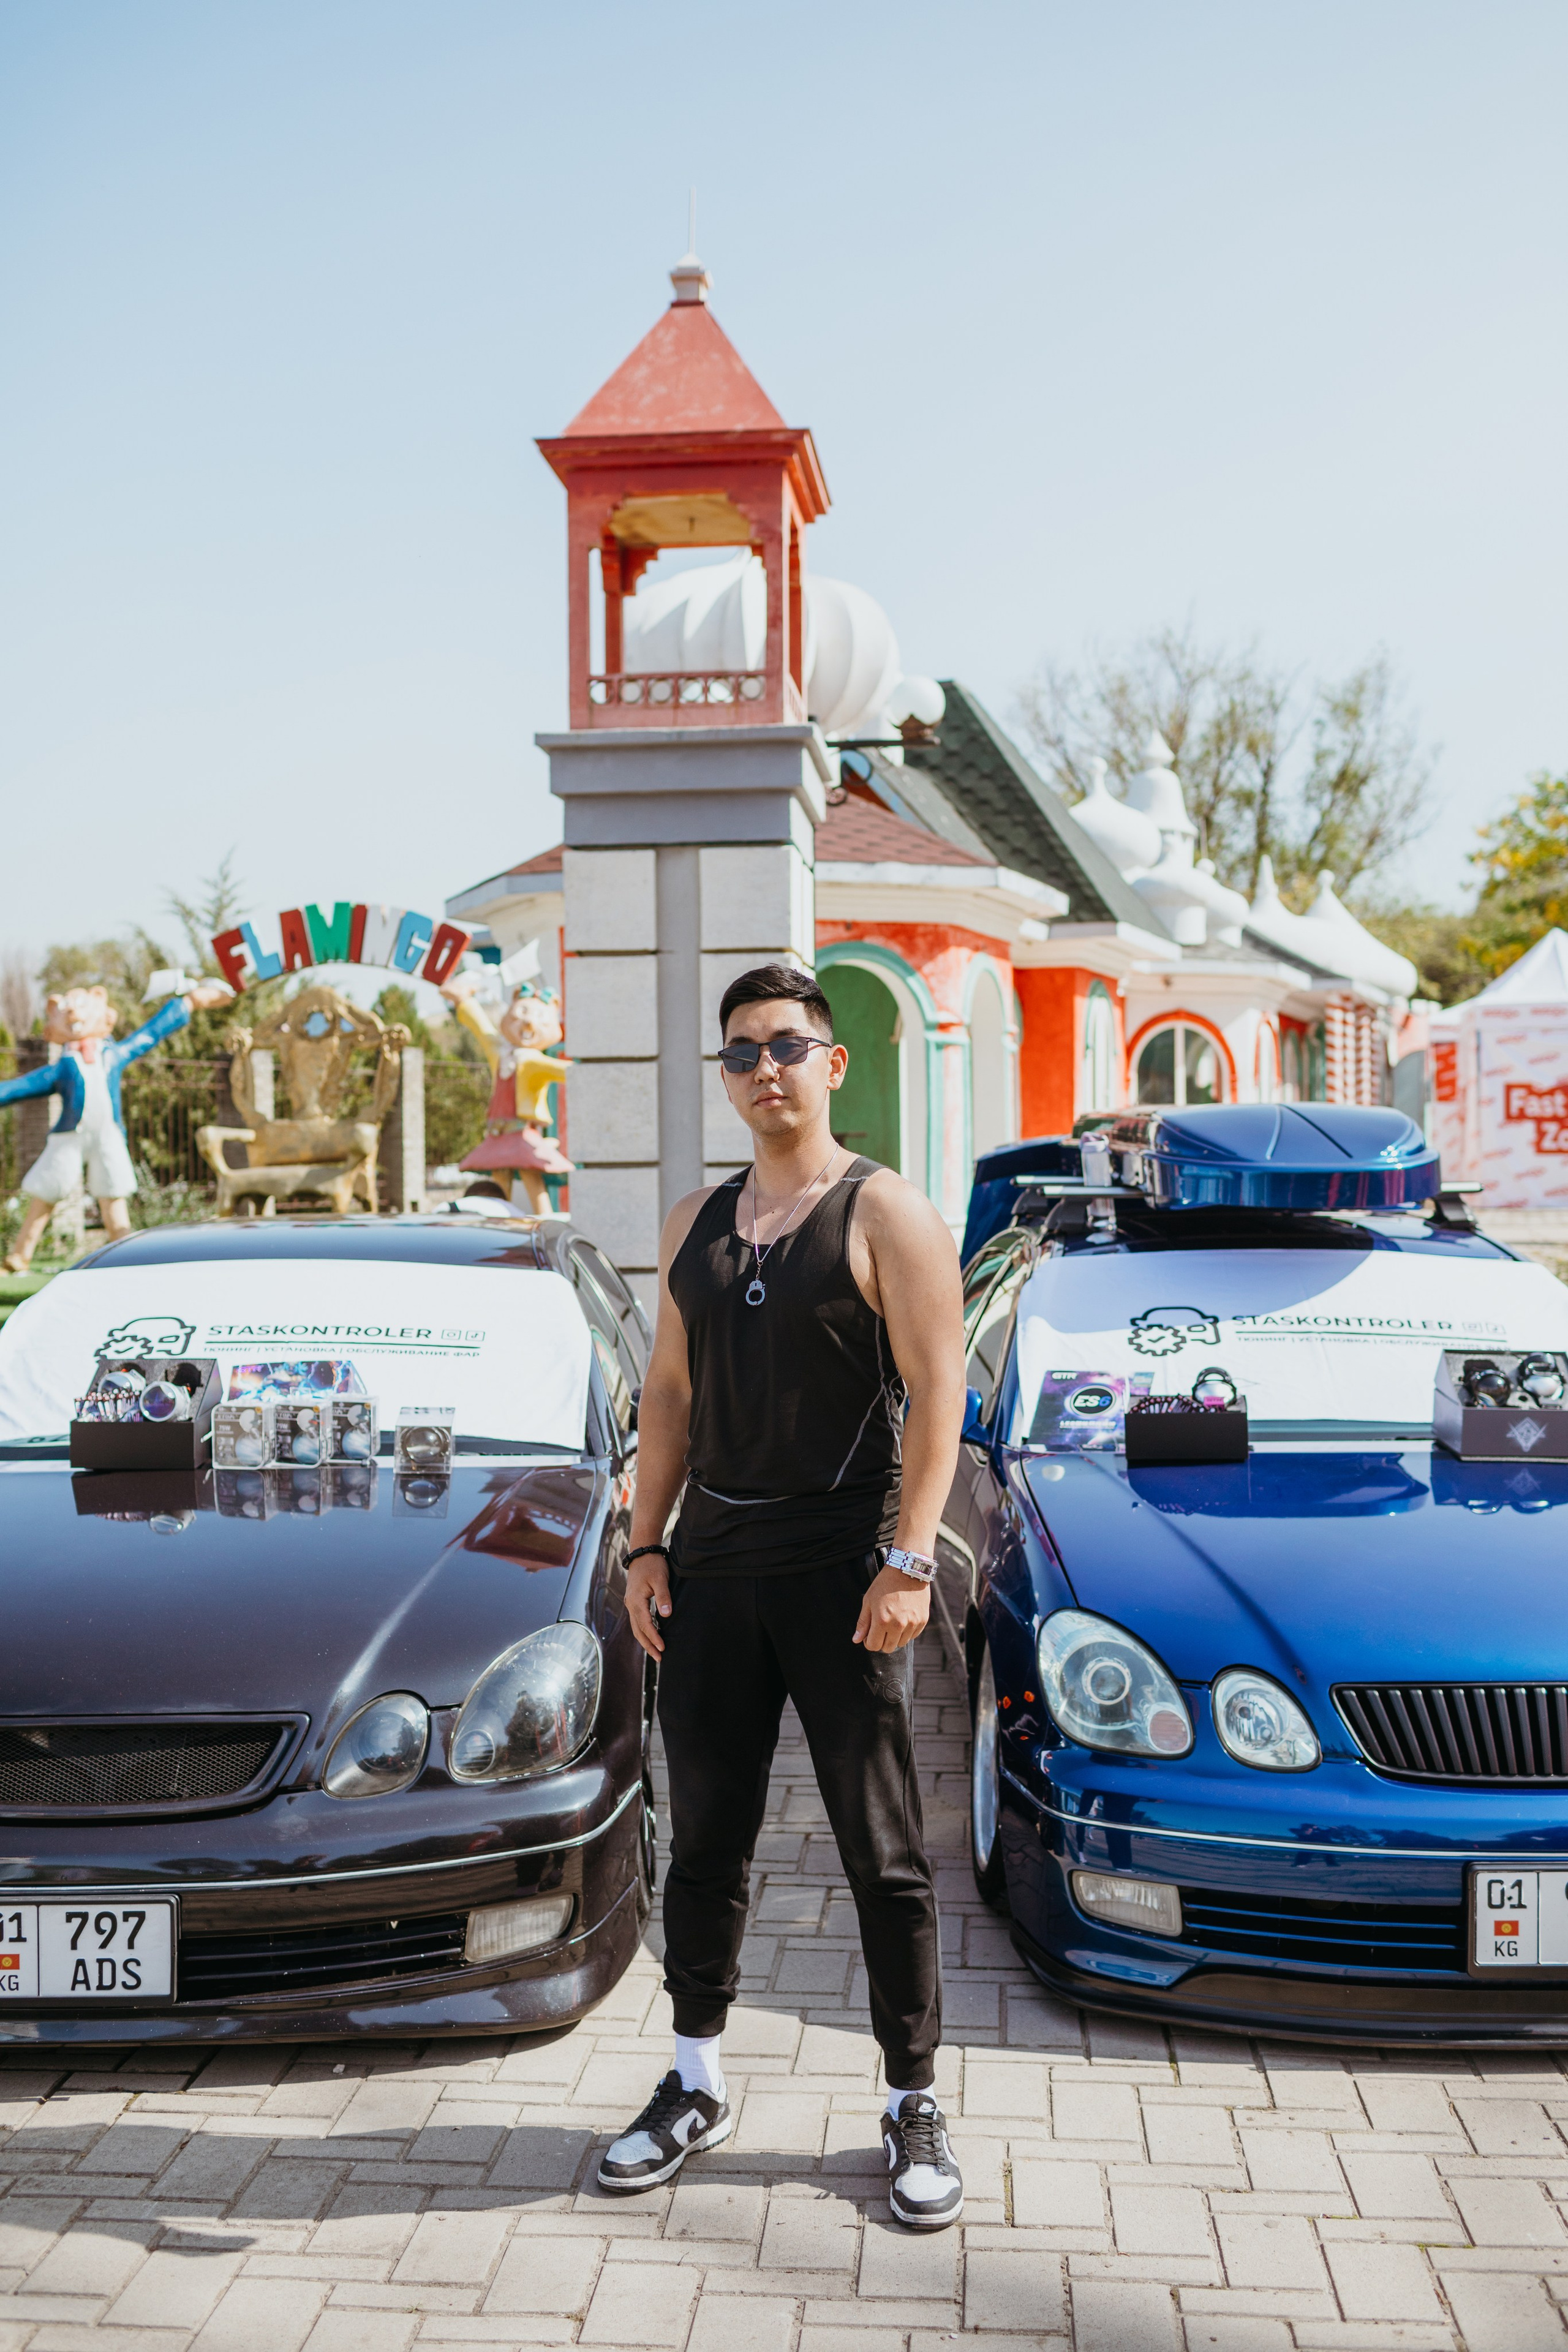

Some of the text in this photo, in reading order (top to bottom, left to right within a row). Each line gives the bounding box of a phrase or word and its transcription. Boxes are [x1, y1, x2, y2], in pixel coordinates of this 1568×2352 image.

[211, 902, 470, 992] FLAMINGO
[1510, 1087, 1567, 1118] Fast
[1231, 1316, 1452, 1330] STASKONTROLER
[208, 1325, 432, 1338] STASKONTROLER
[347, 1348, 449, 1356] ОБСЛУЖИВАНИЕ
[1074, 1395, 1112, 1408] ES6
[0, 1910, 146, 1950] 1 797
[1494, 1941, 1518, 1956] KG
[70, 1958, 141, 1991] ADS
